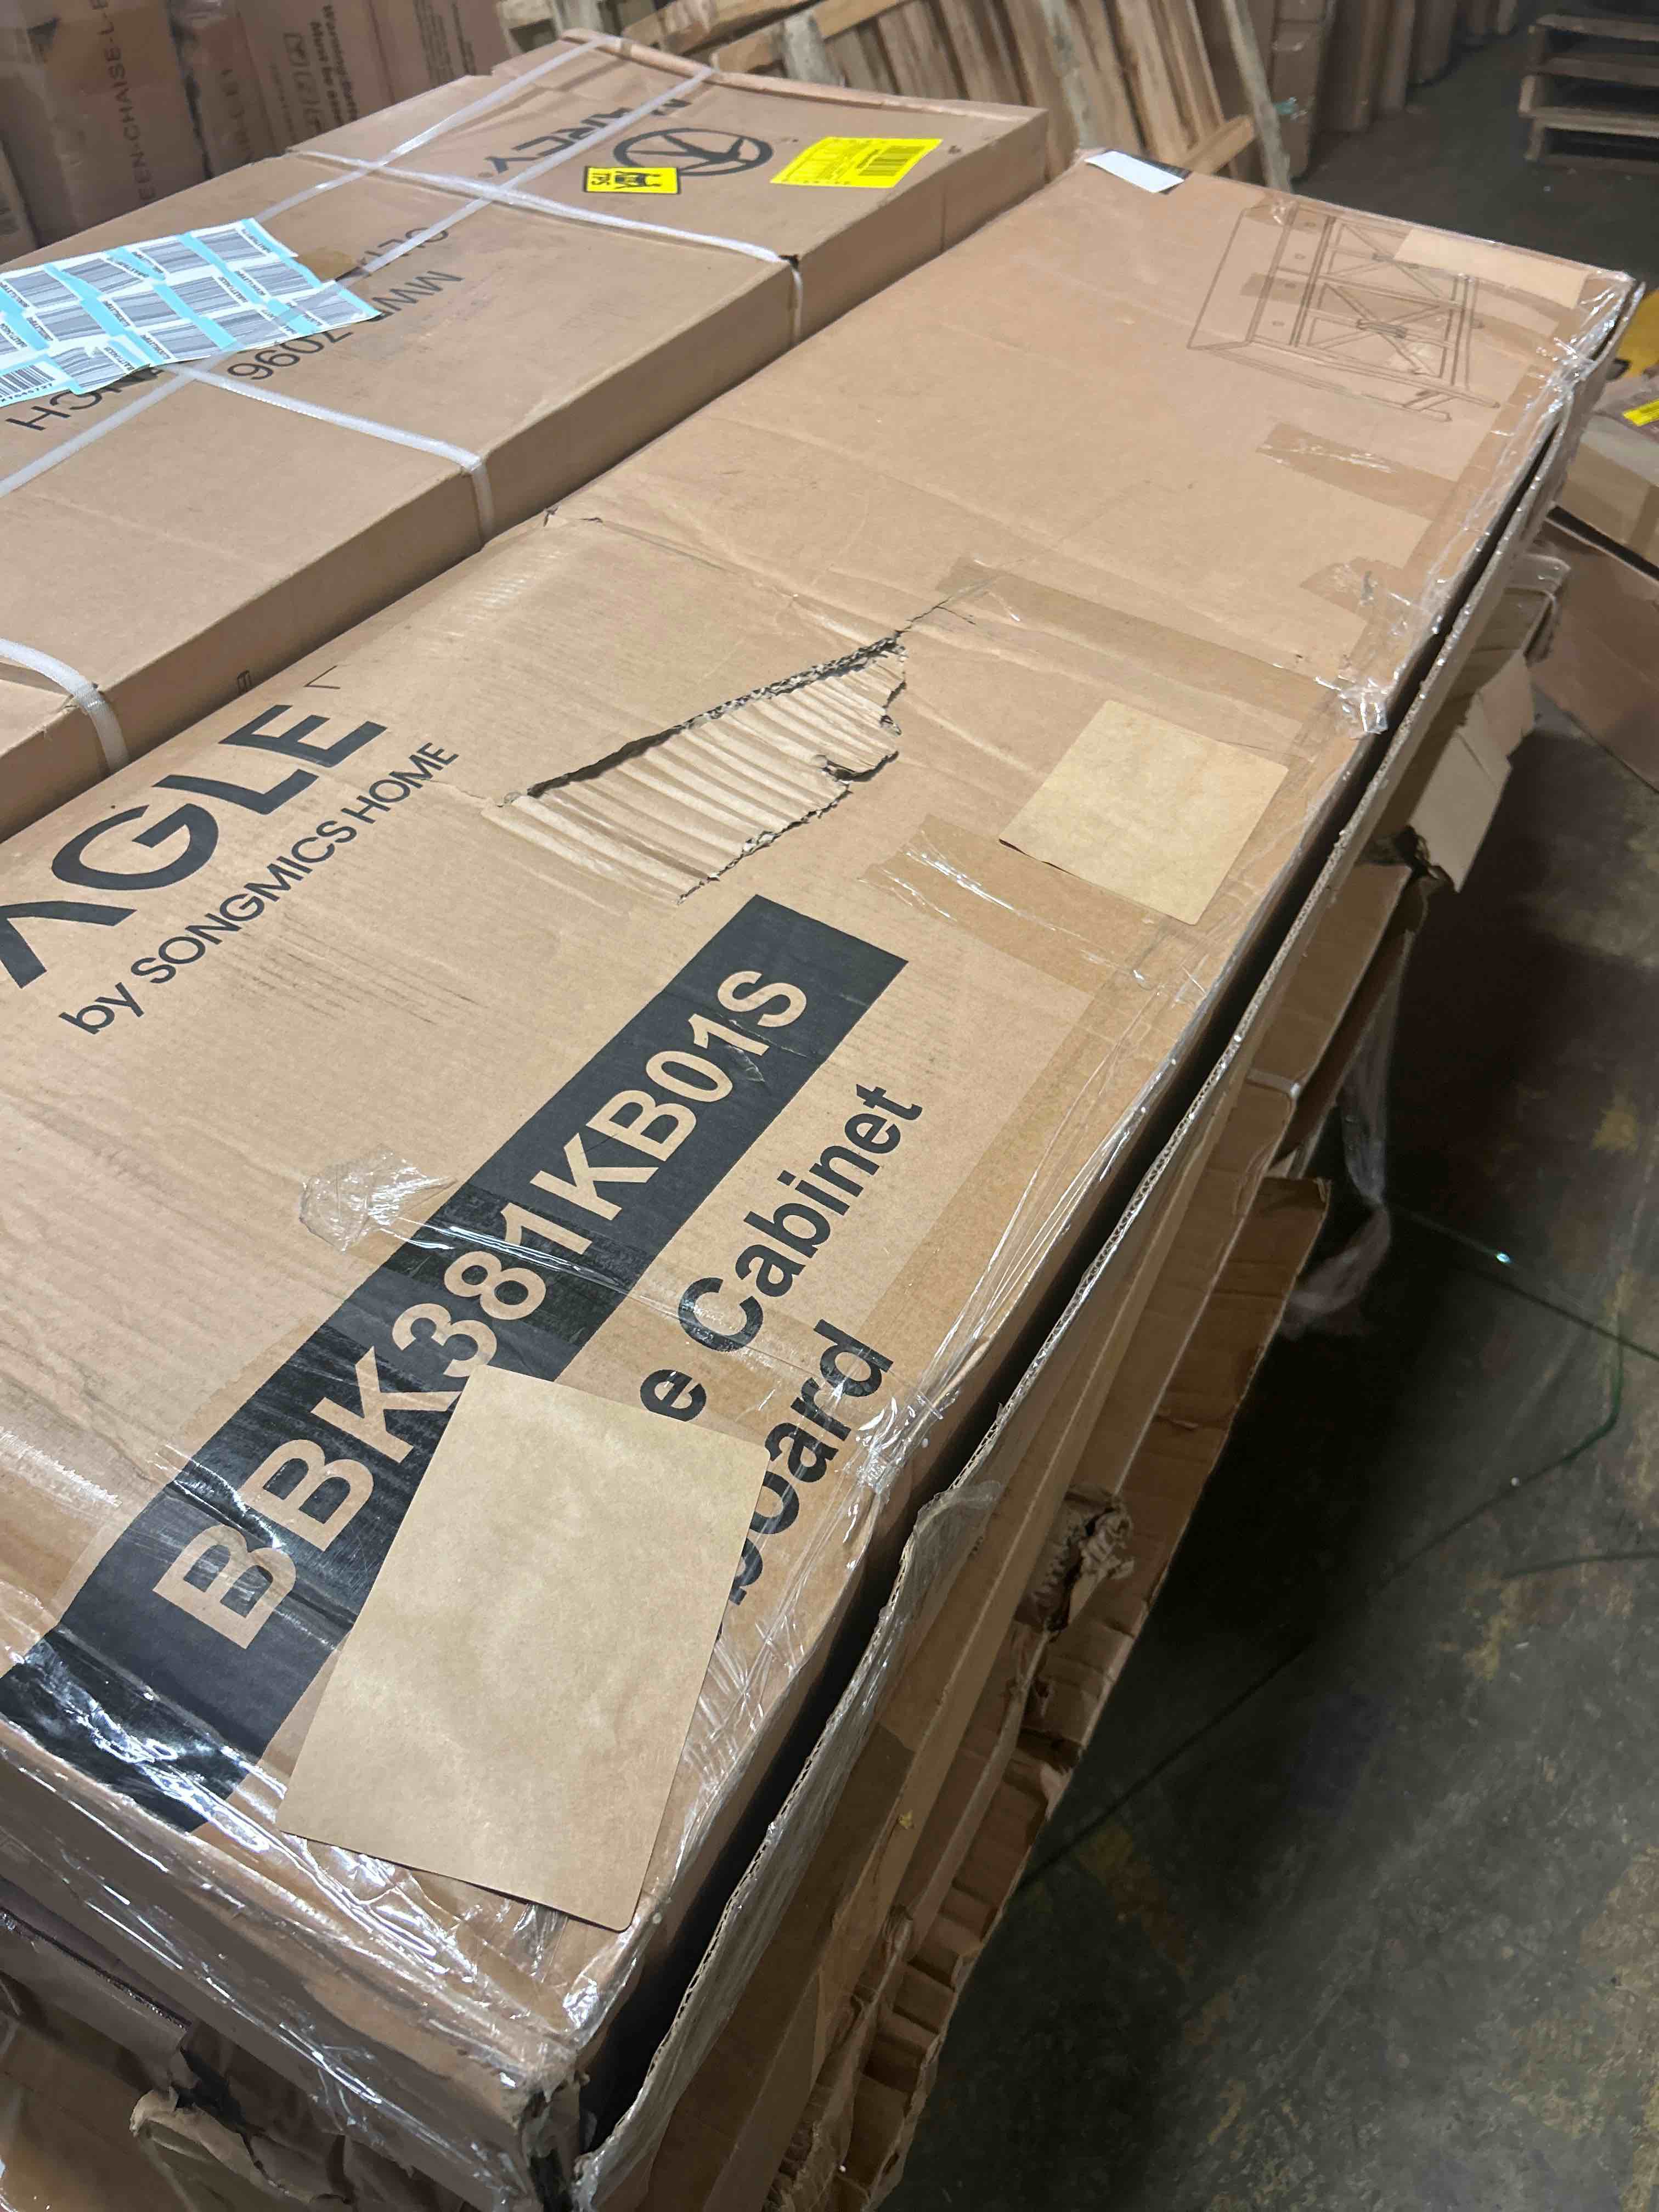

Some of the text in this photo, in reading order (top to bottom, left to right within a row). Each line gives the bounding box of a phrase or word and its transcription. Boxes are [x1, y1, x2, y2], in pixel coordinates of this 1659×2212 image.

[366, 270, 465, 323] MW
[59, 742, 459, 1034] by SONGMICS HOME
[153, 969, 807, 1649] BBK381KB01S
[678, 1084, 923, 1353] Cabinet
